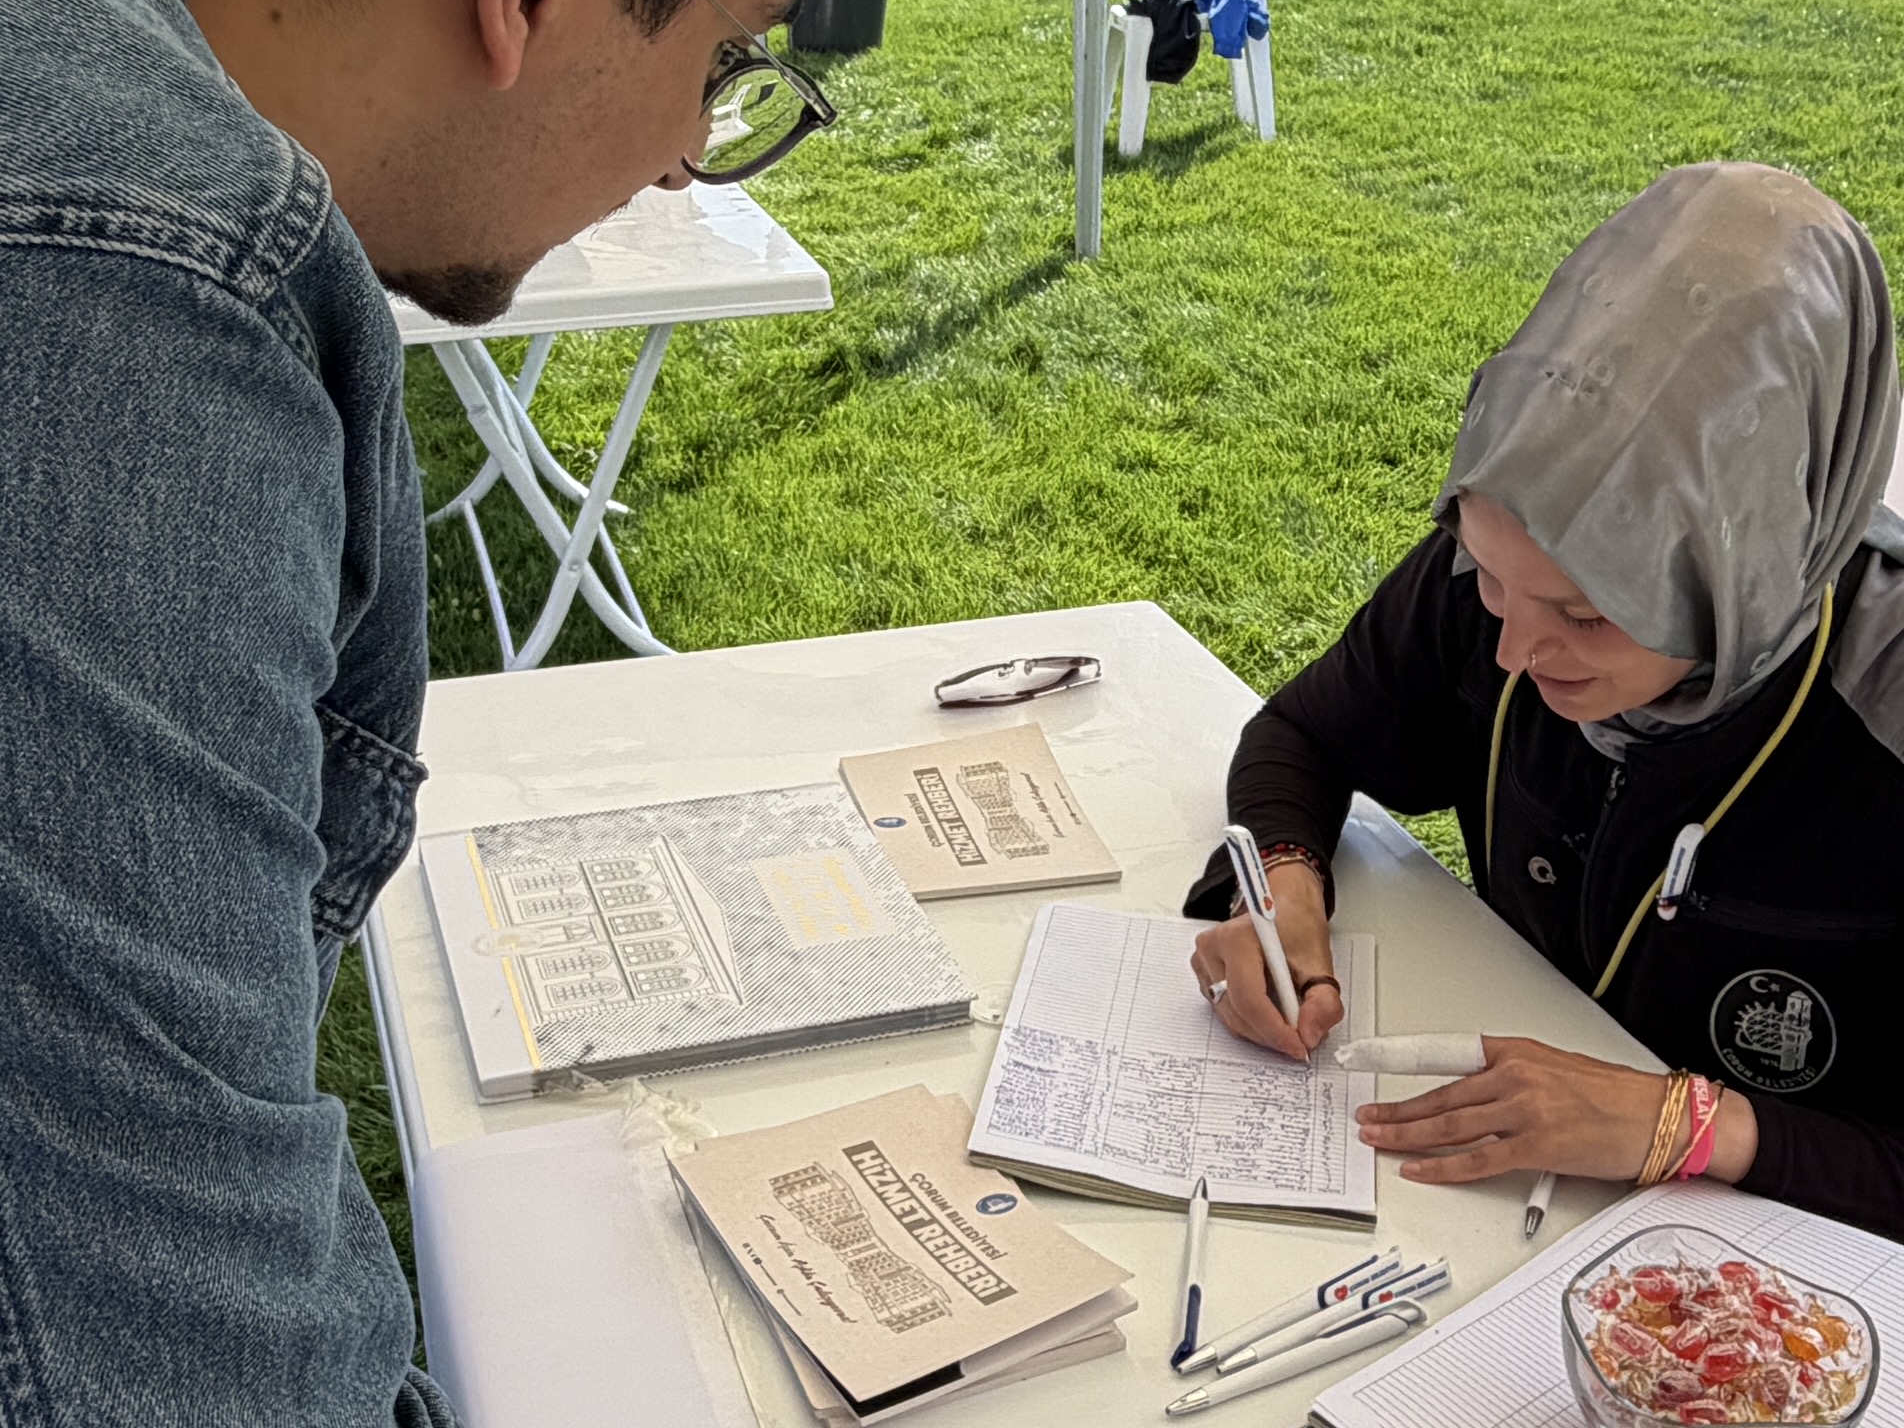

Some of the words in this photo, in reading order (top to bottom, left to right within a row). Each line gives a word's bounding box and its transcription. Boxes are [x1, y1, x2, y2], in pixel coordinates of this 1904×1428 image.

[916, 772, 962, 821] REHBERİ
[948, 821, 982, 864] HİZMET
[851, 1149, 931, 1225] HİZMET
[911, 1222, 1010, 1300] REHBERİ
[908, 1172, 949, 1213] ÇORUM
[943, 1207, 1008, 1261] BELEDİYESİ
